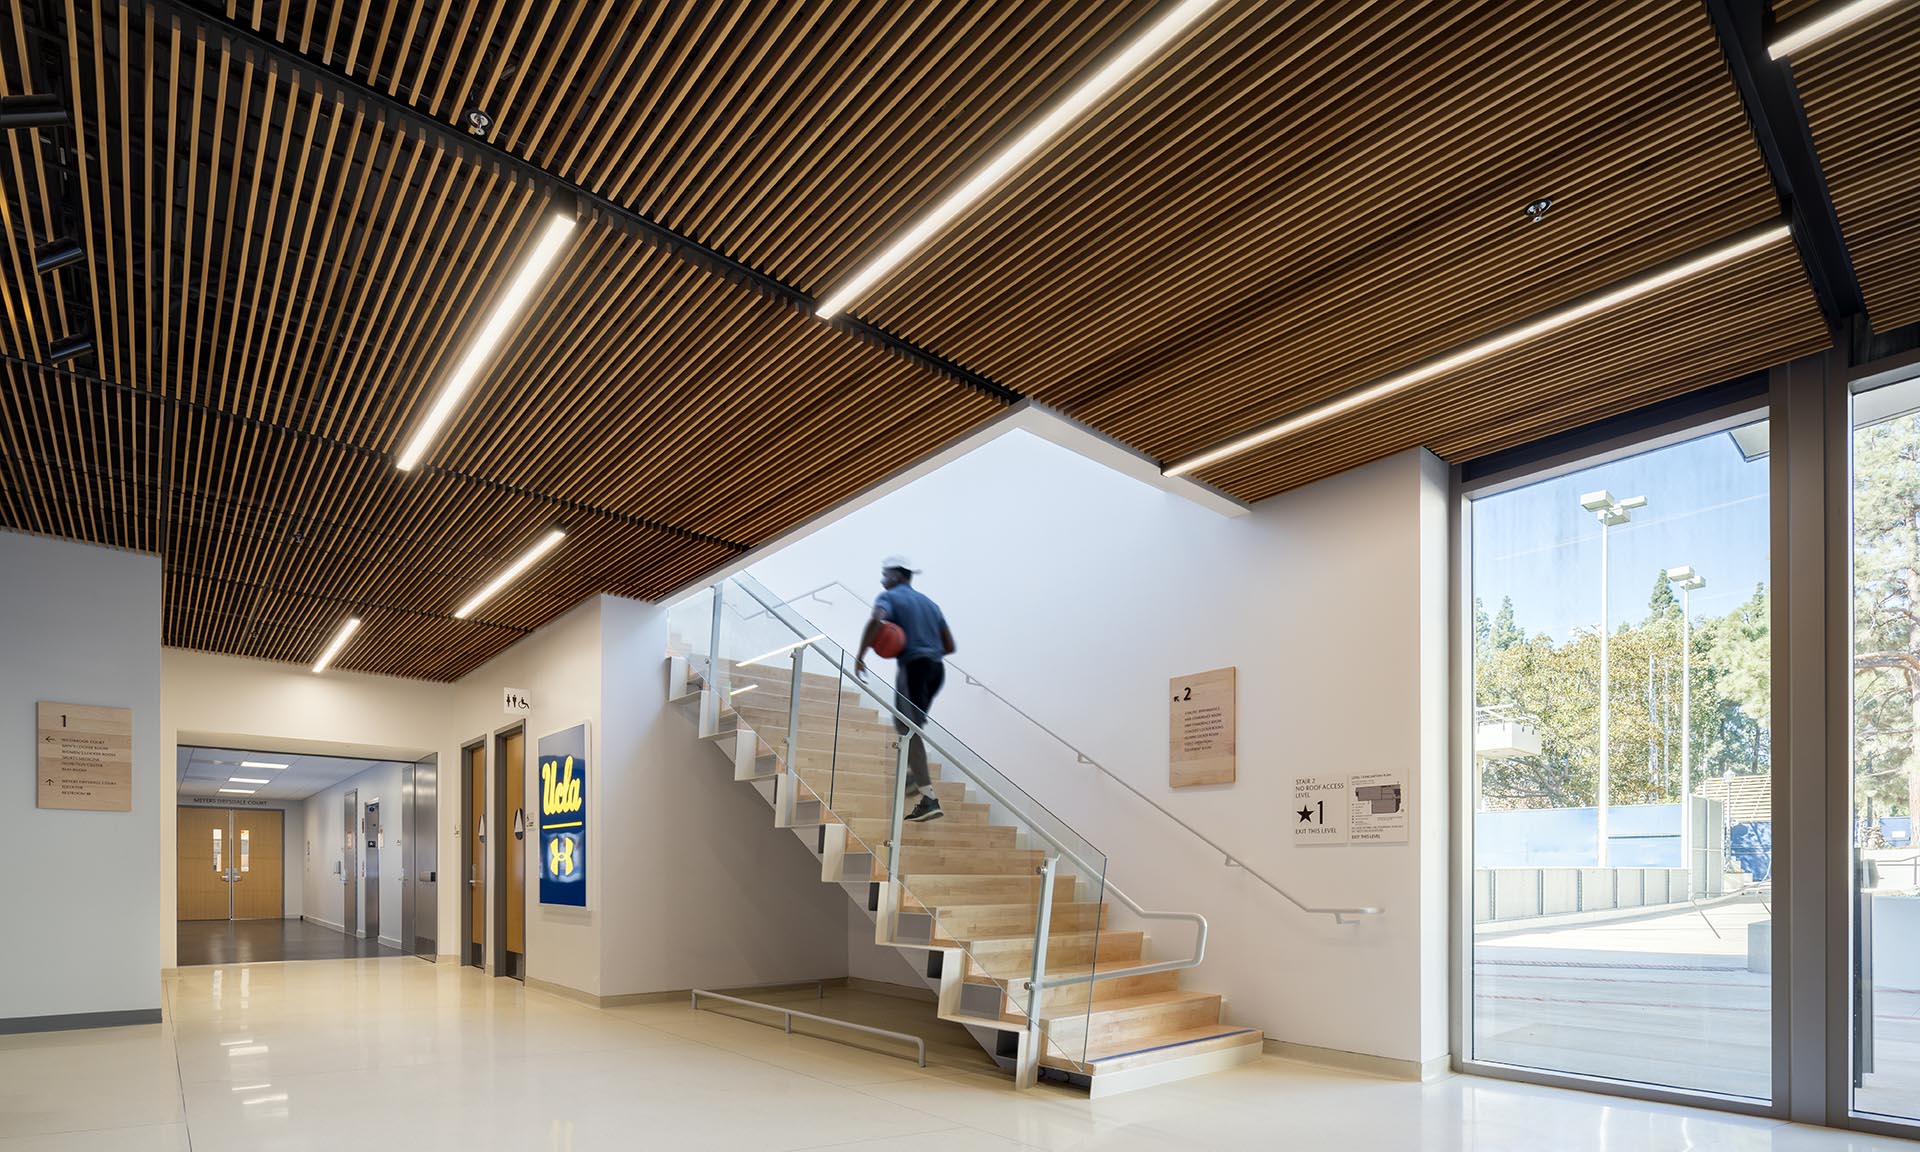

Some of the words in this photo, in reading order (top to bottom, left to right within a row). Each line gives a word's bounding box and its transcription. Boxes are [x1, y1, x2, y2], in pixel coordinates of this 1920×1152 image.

[1183, 686, 1192, 701] 2
[61, 714, 66, 728] 1
[1322, 782, 1344, 790] ACCESS
[1317, 800, 1324, 824] 1
